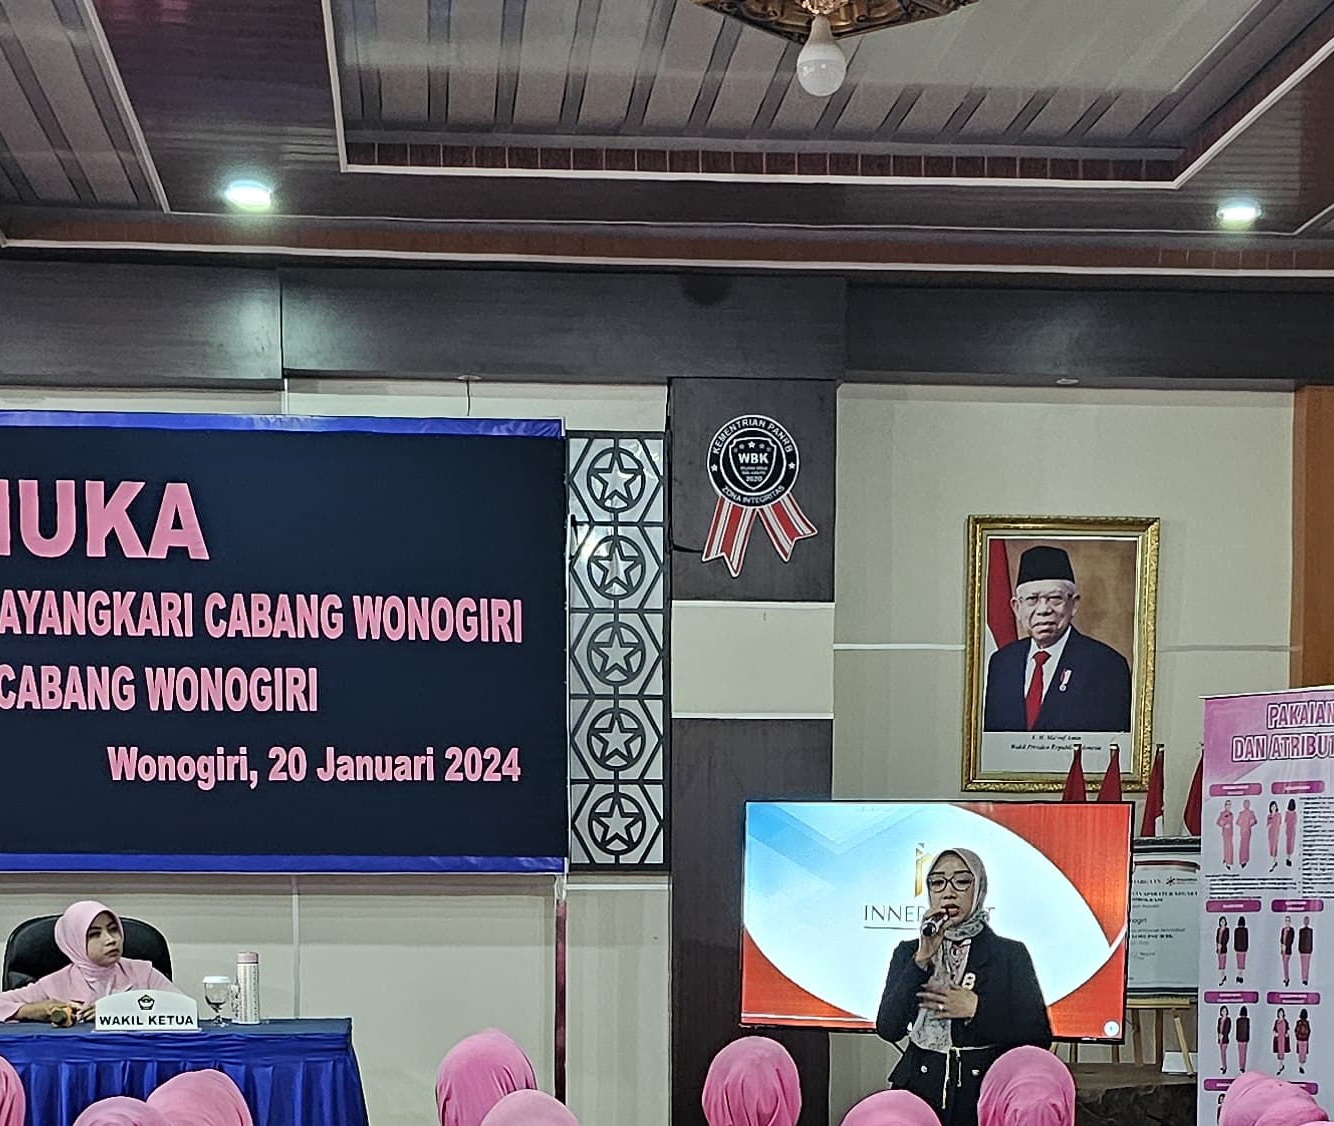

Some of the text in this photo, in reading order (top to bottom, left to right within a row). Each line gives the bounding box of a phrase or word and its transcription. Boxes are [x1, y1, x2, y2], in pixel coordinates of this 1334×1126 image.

[737, 452, 769, 464] WBK
[204, 592, 344, 640] CABANG
[352, 595, 523, 644] WONOGIRI
[144, 666, 319, 712] WONOGIRI
[1231, 736, 1268, 762] DAN
[106, 746, 521, 791] Wonogiri, 20 Januari 2024
[99, 1015, 194, 1026] WAKIL KETUA
